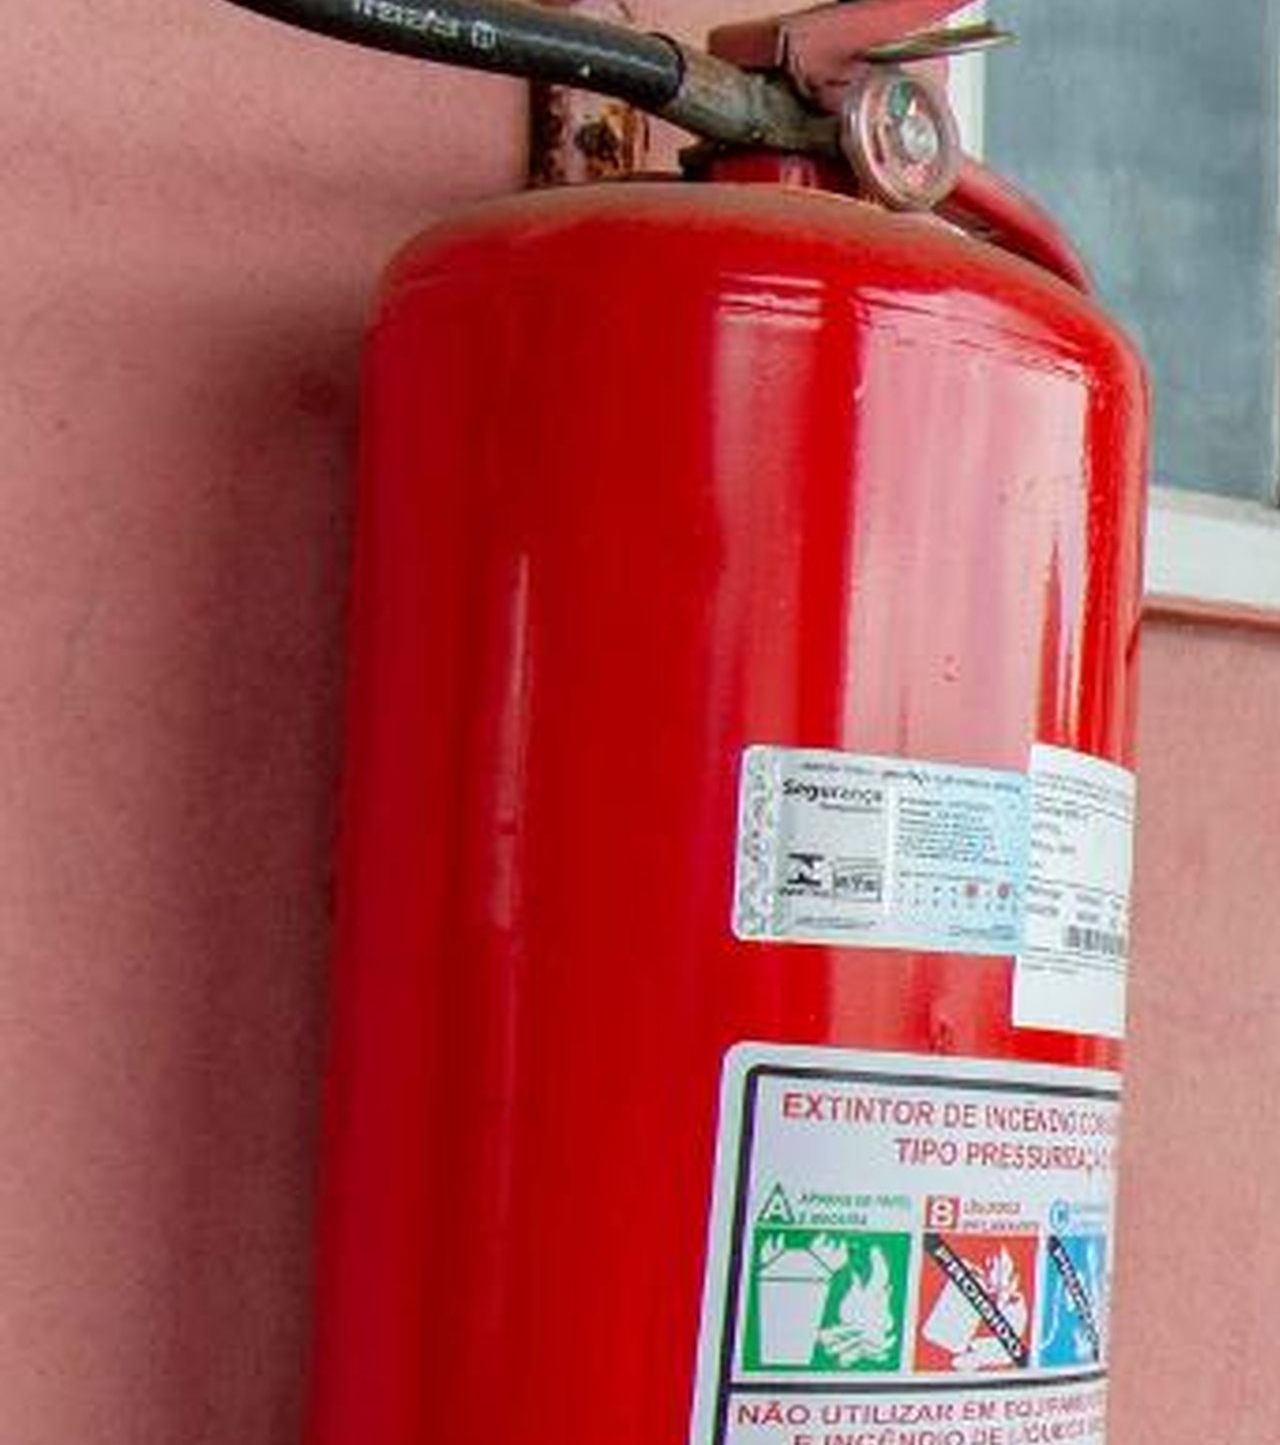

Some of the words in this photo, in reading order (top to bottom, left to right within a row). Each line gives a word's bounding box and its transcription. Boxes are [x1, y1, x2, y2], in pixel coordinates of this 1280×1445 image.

[783, 778, 882, 804] Segurança
[783, 1091, 933, 1125] EXTINTOR
[944, 1103, 979, 1128] DE
[986, 1101, 1077, 1135] INCÊNDIO
[896, 1138, 957, 1166] TIPO
[737, 1400, 811, 1425] NÃO
[821, 1403, 953, 1426] UTILIZAR
[963, 1400, 995, 1421] EM
